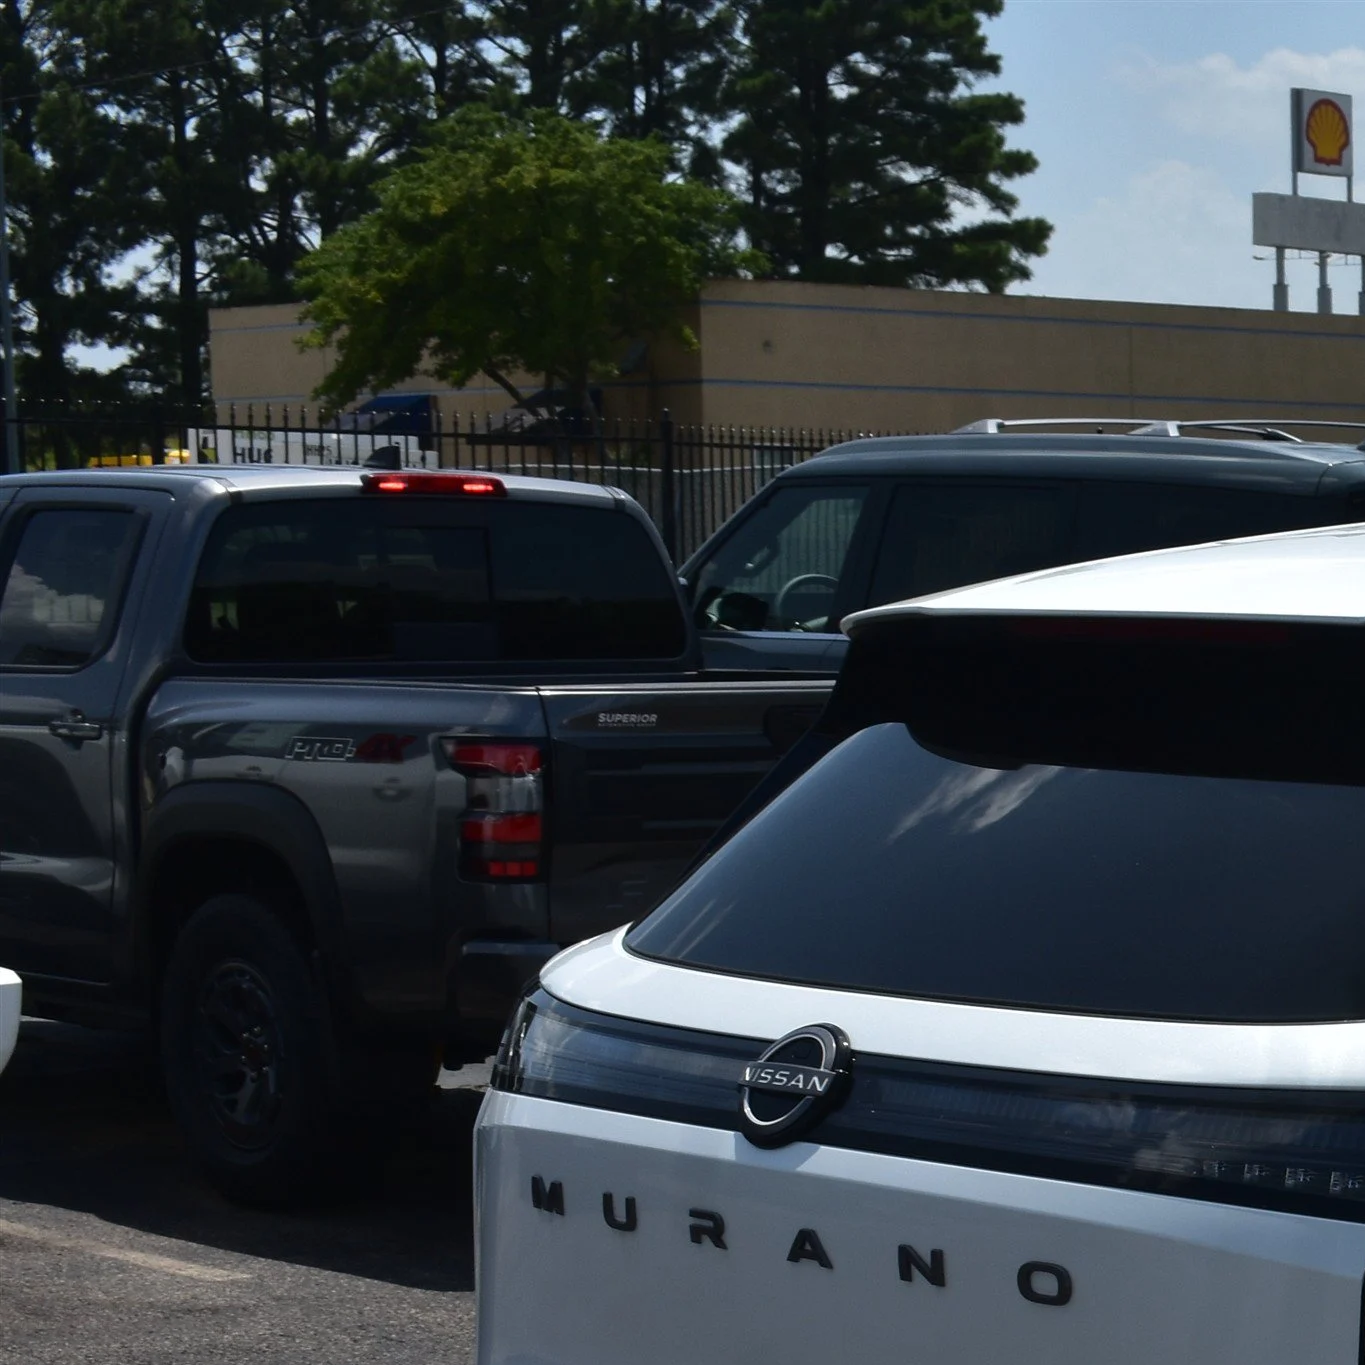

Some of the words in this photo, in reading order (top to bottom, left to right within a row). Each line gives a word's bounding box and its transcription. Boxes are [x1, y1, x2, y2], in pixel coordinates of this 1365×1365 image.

[598, 713, 658, 723] SUPERIOR
[745, 1067, 829, 1092] NISSAN
[531, 1174, 1073, 1306] MURANO
